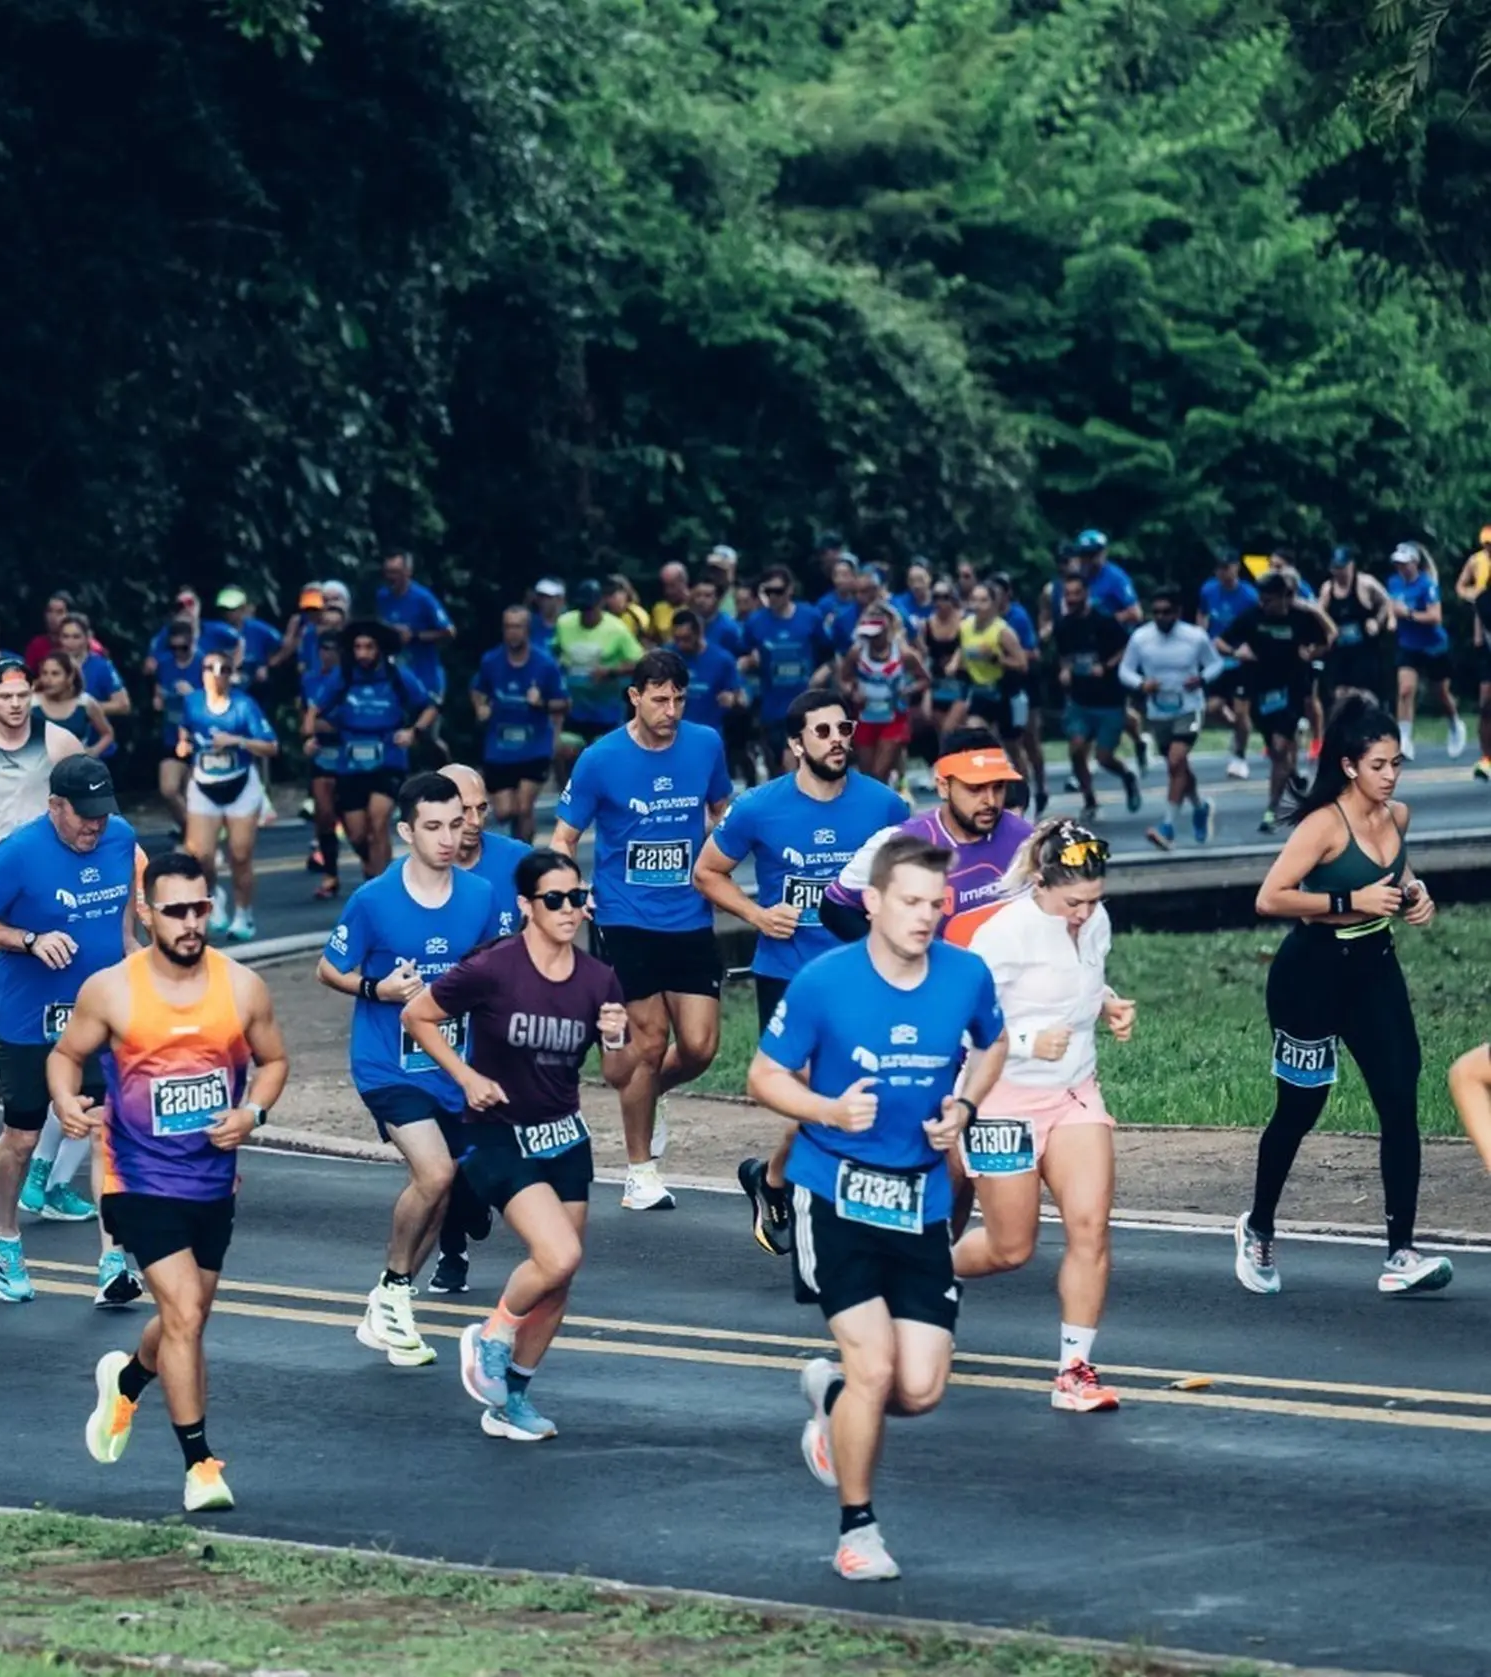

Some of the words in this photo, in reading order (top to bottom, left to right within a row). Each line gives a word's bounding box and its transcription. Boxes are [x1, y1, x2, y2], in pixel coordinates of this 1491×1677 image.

[635, 848, 682, 871] 22139
[507, 1012, 586, 1051] GUMP
[1282, 1042, 1327, 1071] 21737
[160, 1080, 224, 1116] 22066
[525, 1115, 580, 1153] 22159
[970, 1126, 1023, 1154] 21307
[847, 1171, 911, 1211] 21324
